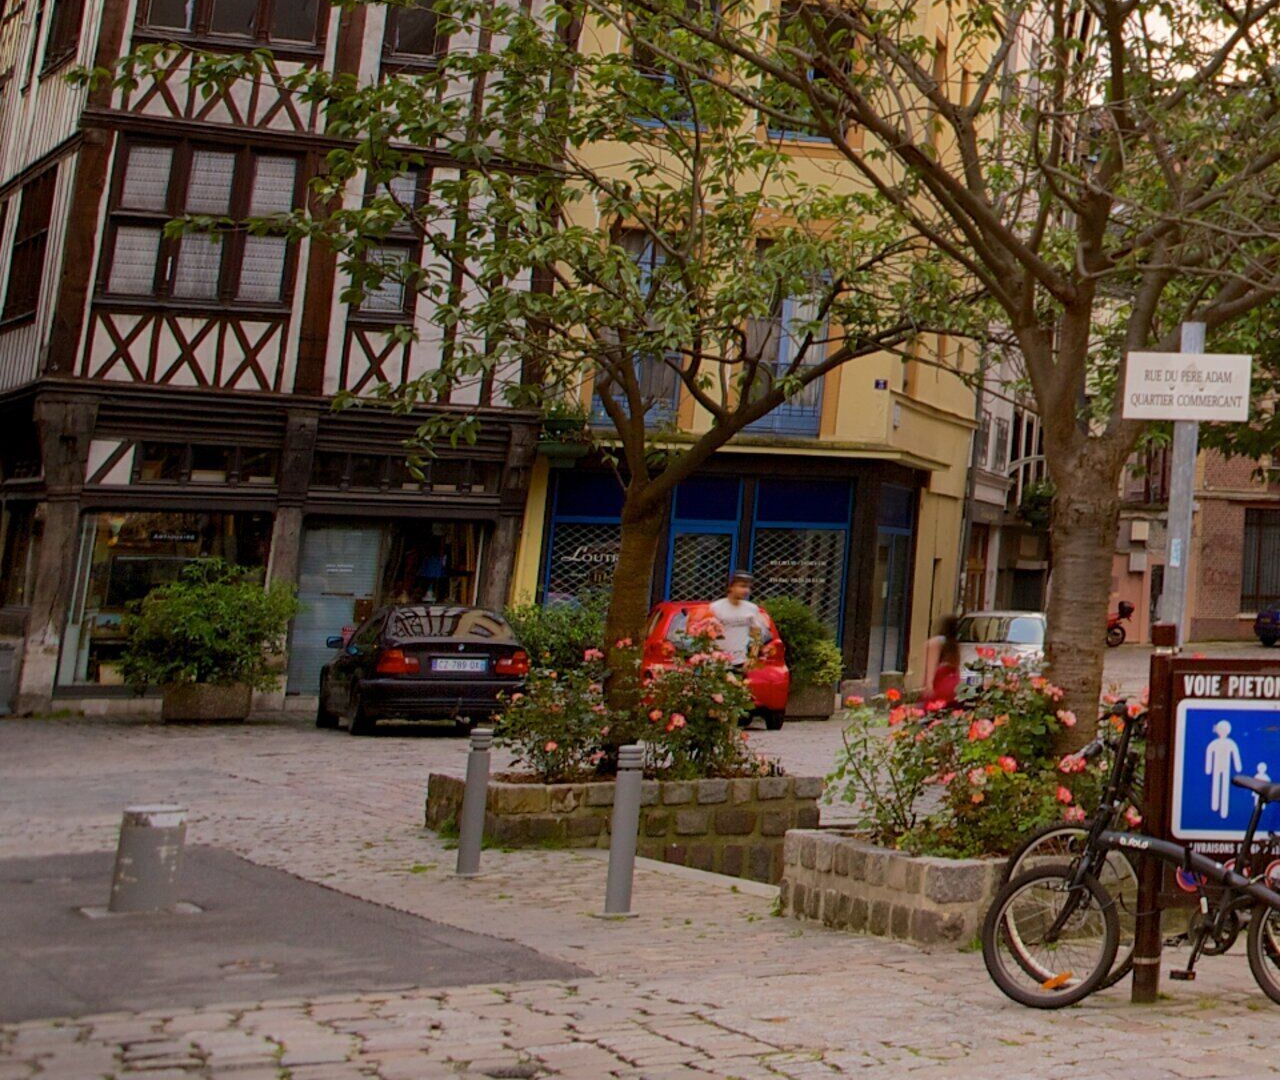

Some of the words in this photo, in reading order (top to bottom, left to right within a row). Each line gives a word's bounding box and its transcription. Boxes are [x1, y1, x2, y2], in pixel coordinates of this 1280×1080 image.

[1144, 369, 1162, 382] RUE
[1164, 370, 1178, 382] DU
[1205, 371, 1232, 384] ADAM
[1130, 393, 1175, 408] QUARTIER
[1183, 674, 1222, 697] VOIE
